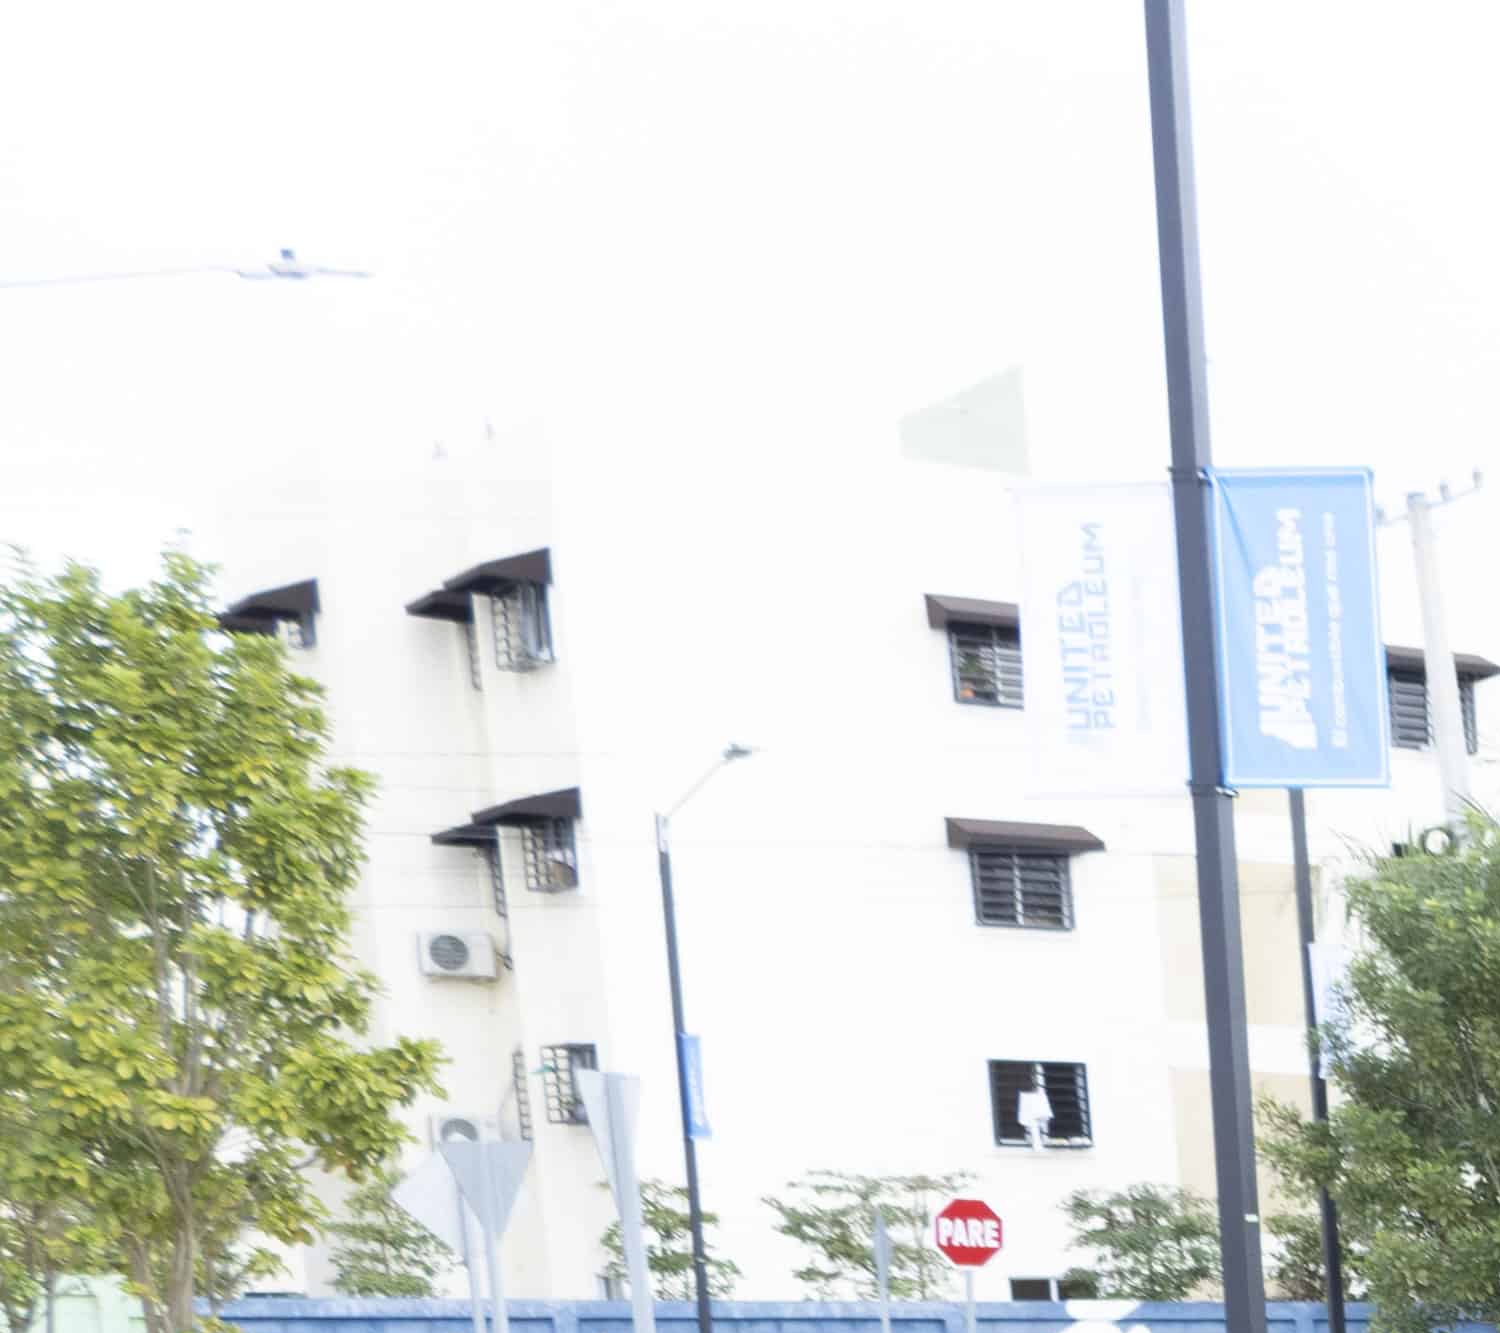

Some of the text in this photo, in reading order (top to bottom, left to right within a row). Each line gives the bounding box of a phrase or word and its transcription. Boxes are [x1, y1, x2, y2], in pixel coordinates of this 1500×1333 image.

[1056, 579, 1092, 732] UNITED
[1080, 521, 1116, 730] PETROLEUM
[1252, 564, 1288, 724] UNITED
[938, 1217, 1001, 1249] PARE
